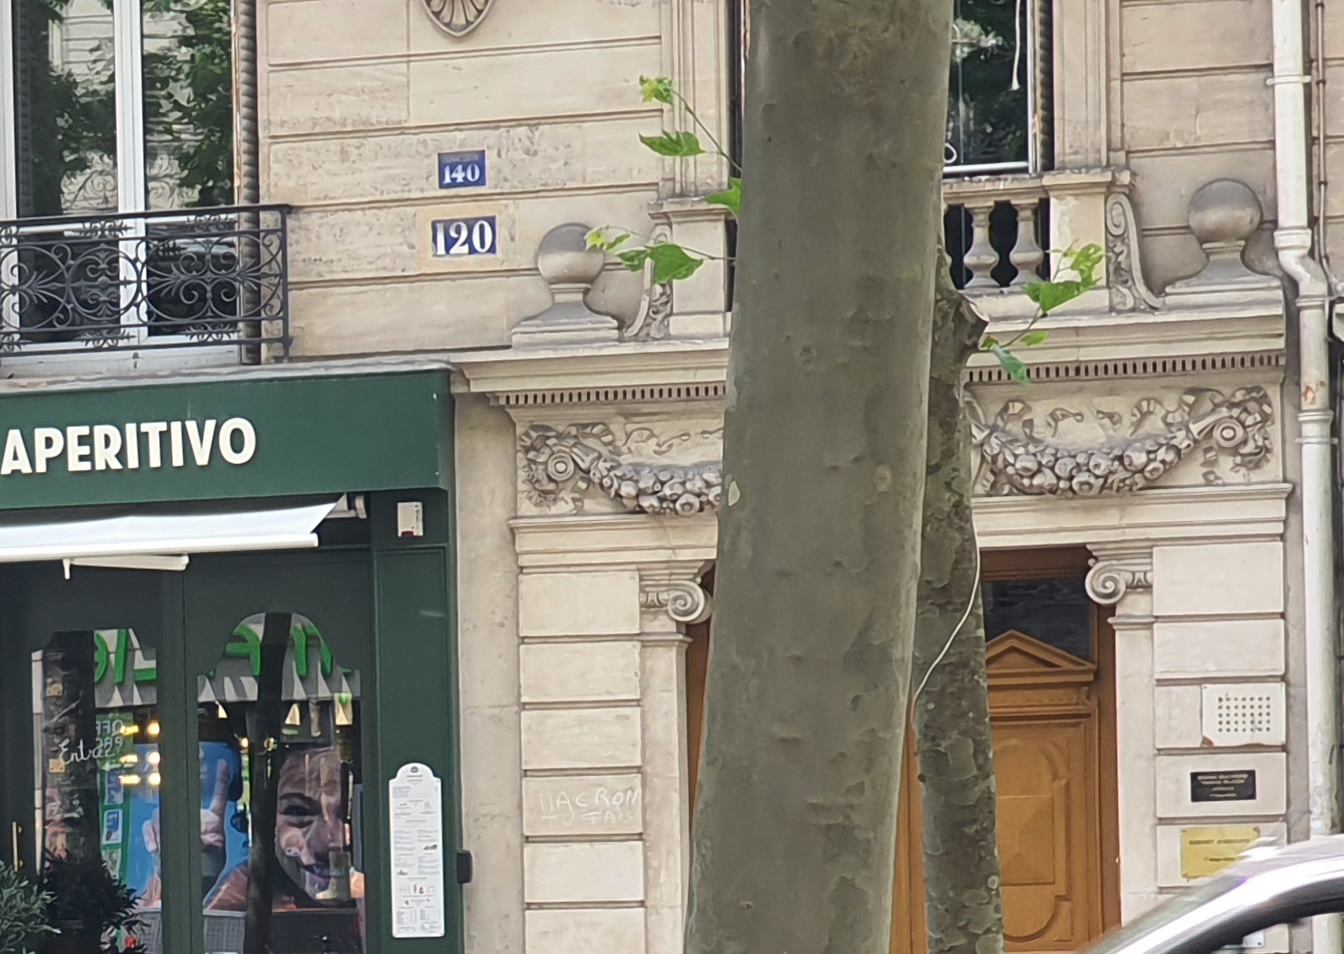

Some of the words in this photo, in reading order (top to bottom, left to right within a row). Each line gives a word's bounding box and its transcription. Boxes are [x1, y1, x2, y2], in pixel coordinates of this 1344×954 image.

[443, 163, 480, 185] 140
[436, 219, 493, 256] 120
[0, 417, 257, 475] APERITIVO
